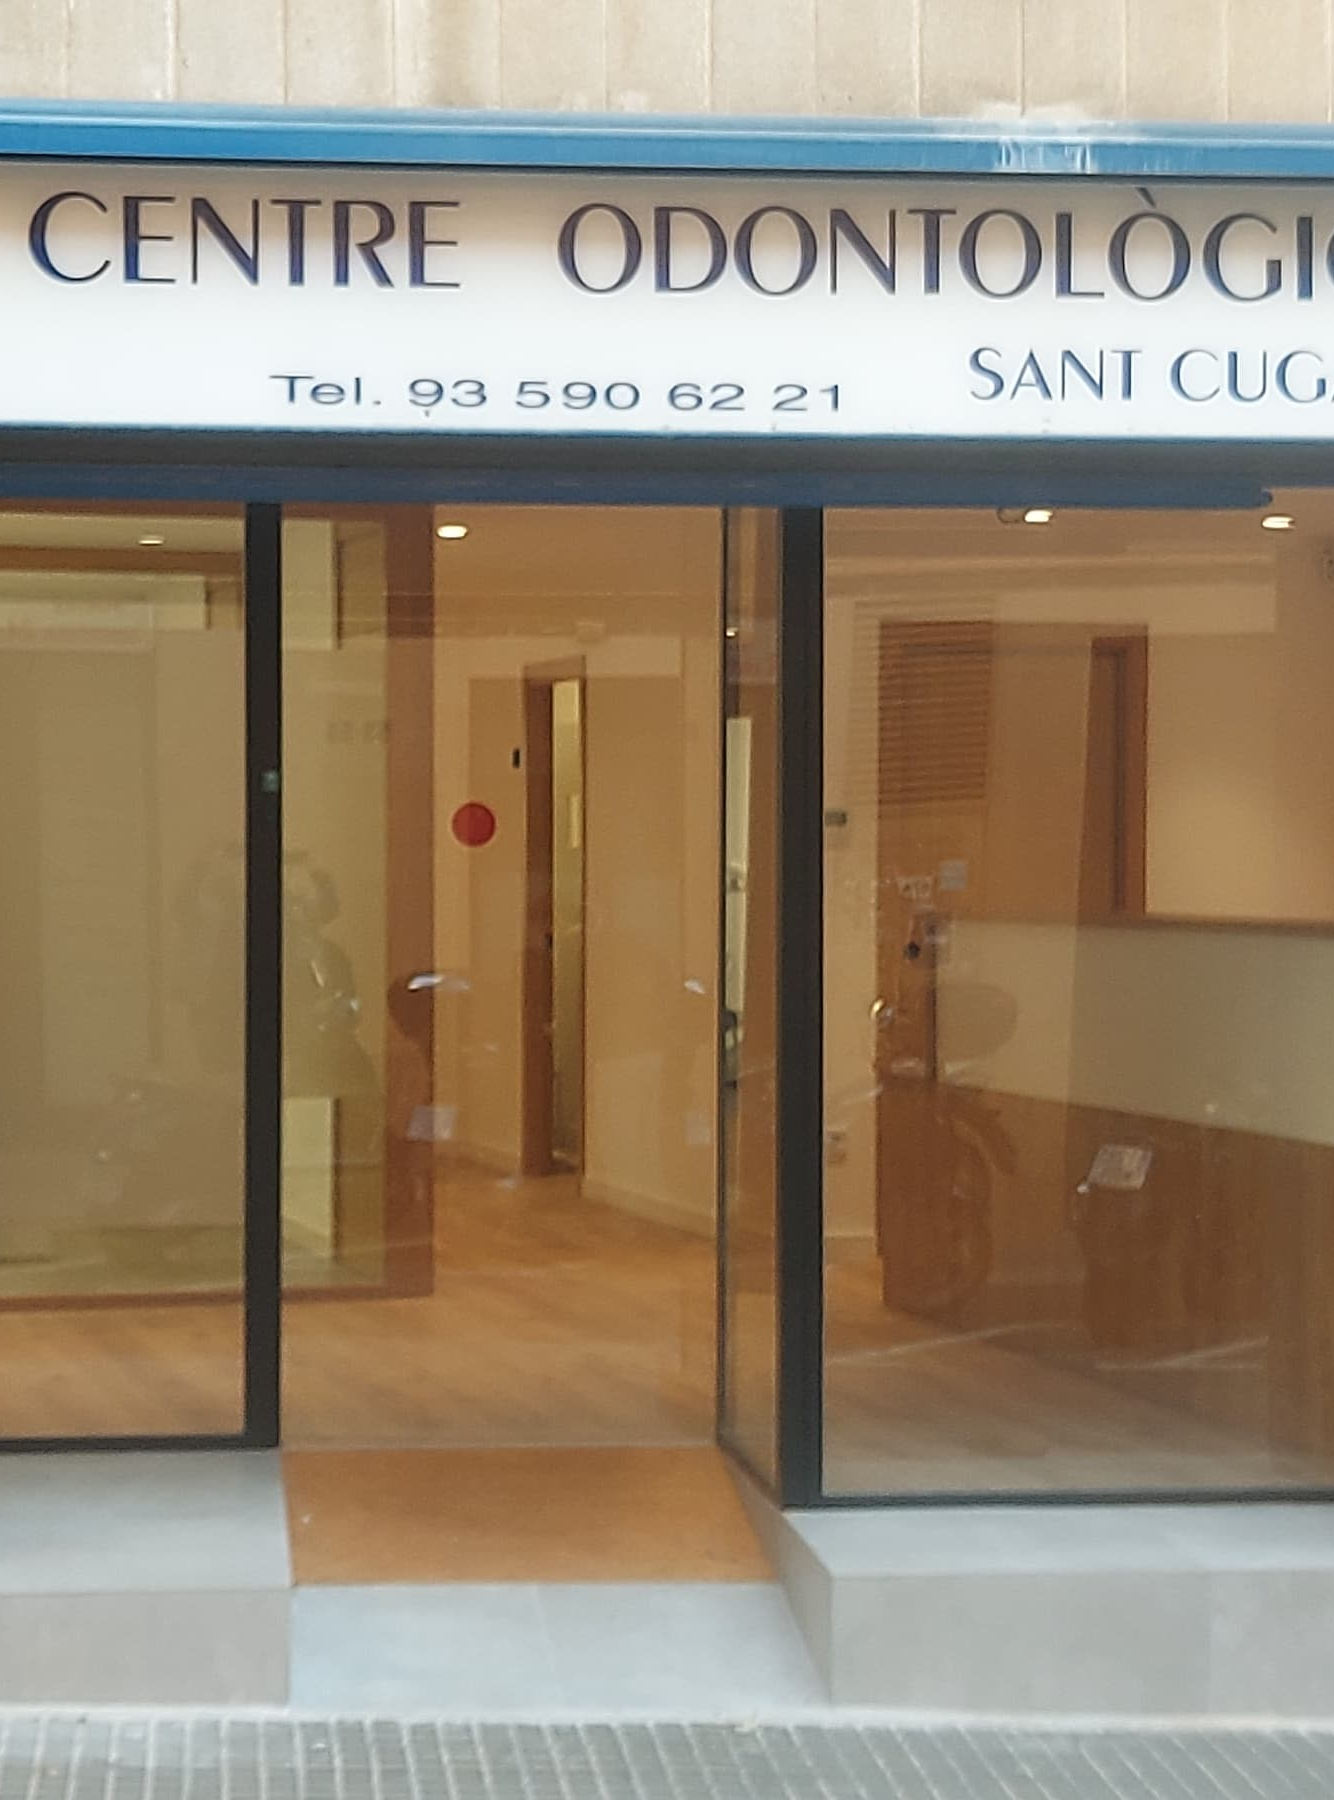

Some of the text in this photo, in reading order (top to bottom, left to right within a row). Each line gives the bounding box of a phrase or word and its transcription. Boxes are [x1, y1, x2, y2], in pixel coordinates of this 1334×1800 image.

[28, 190, 462, 289] CENTRE
[269, 374, 840, 413] Tel. 93 590 62 21
[969, 346, 1143, 402] SANT
